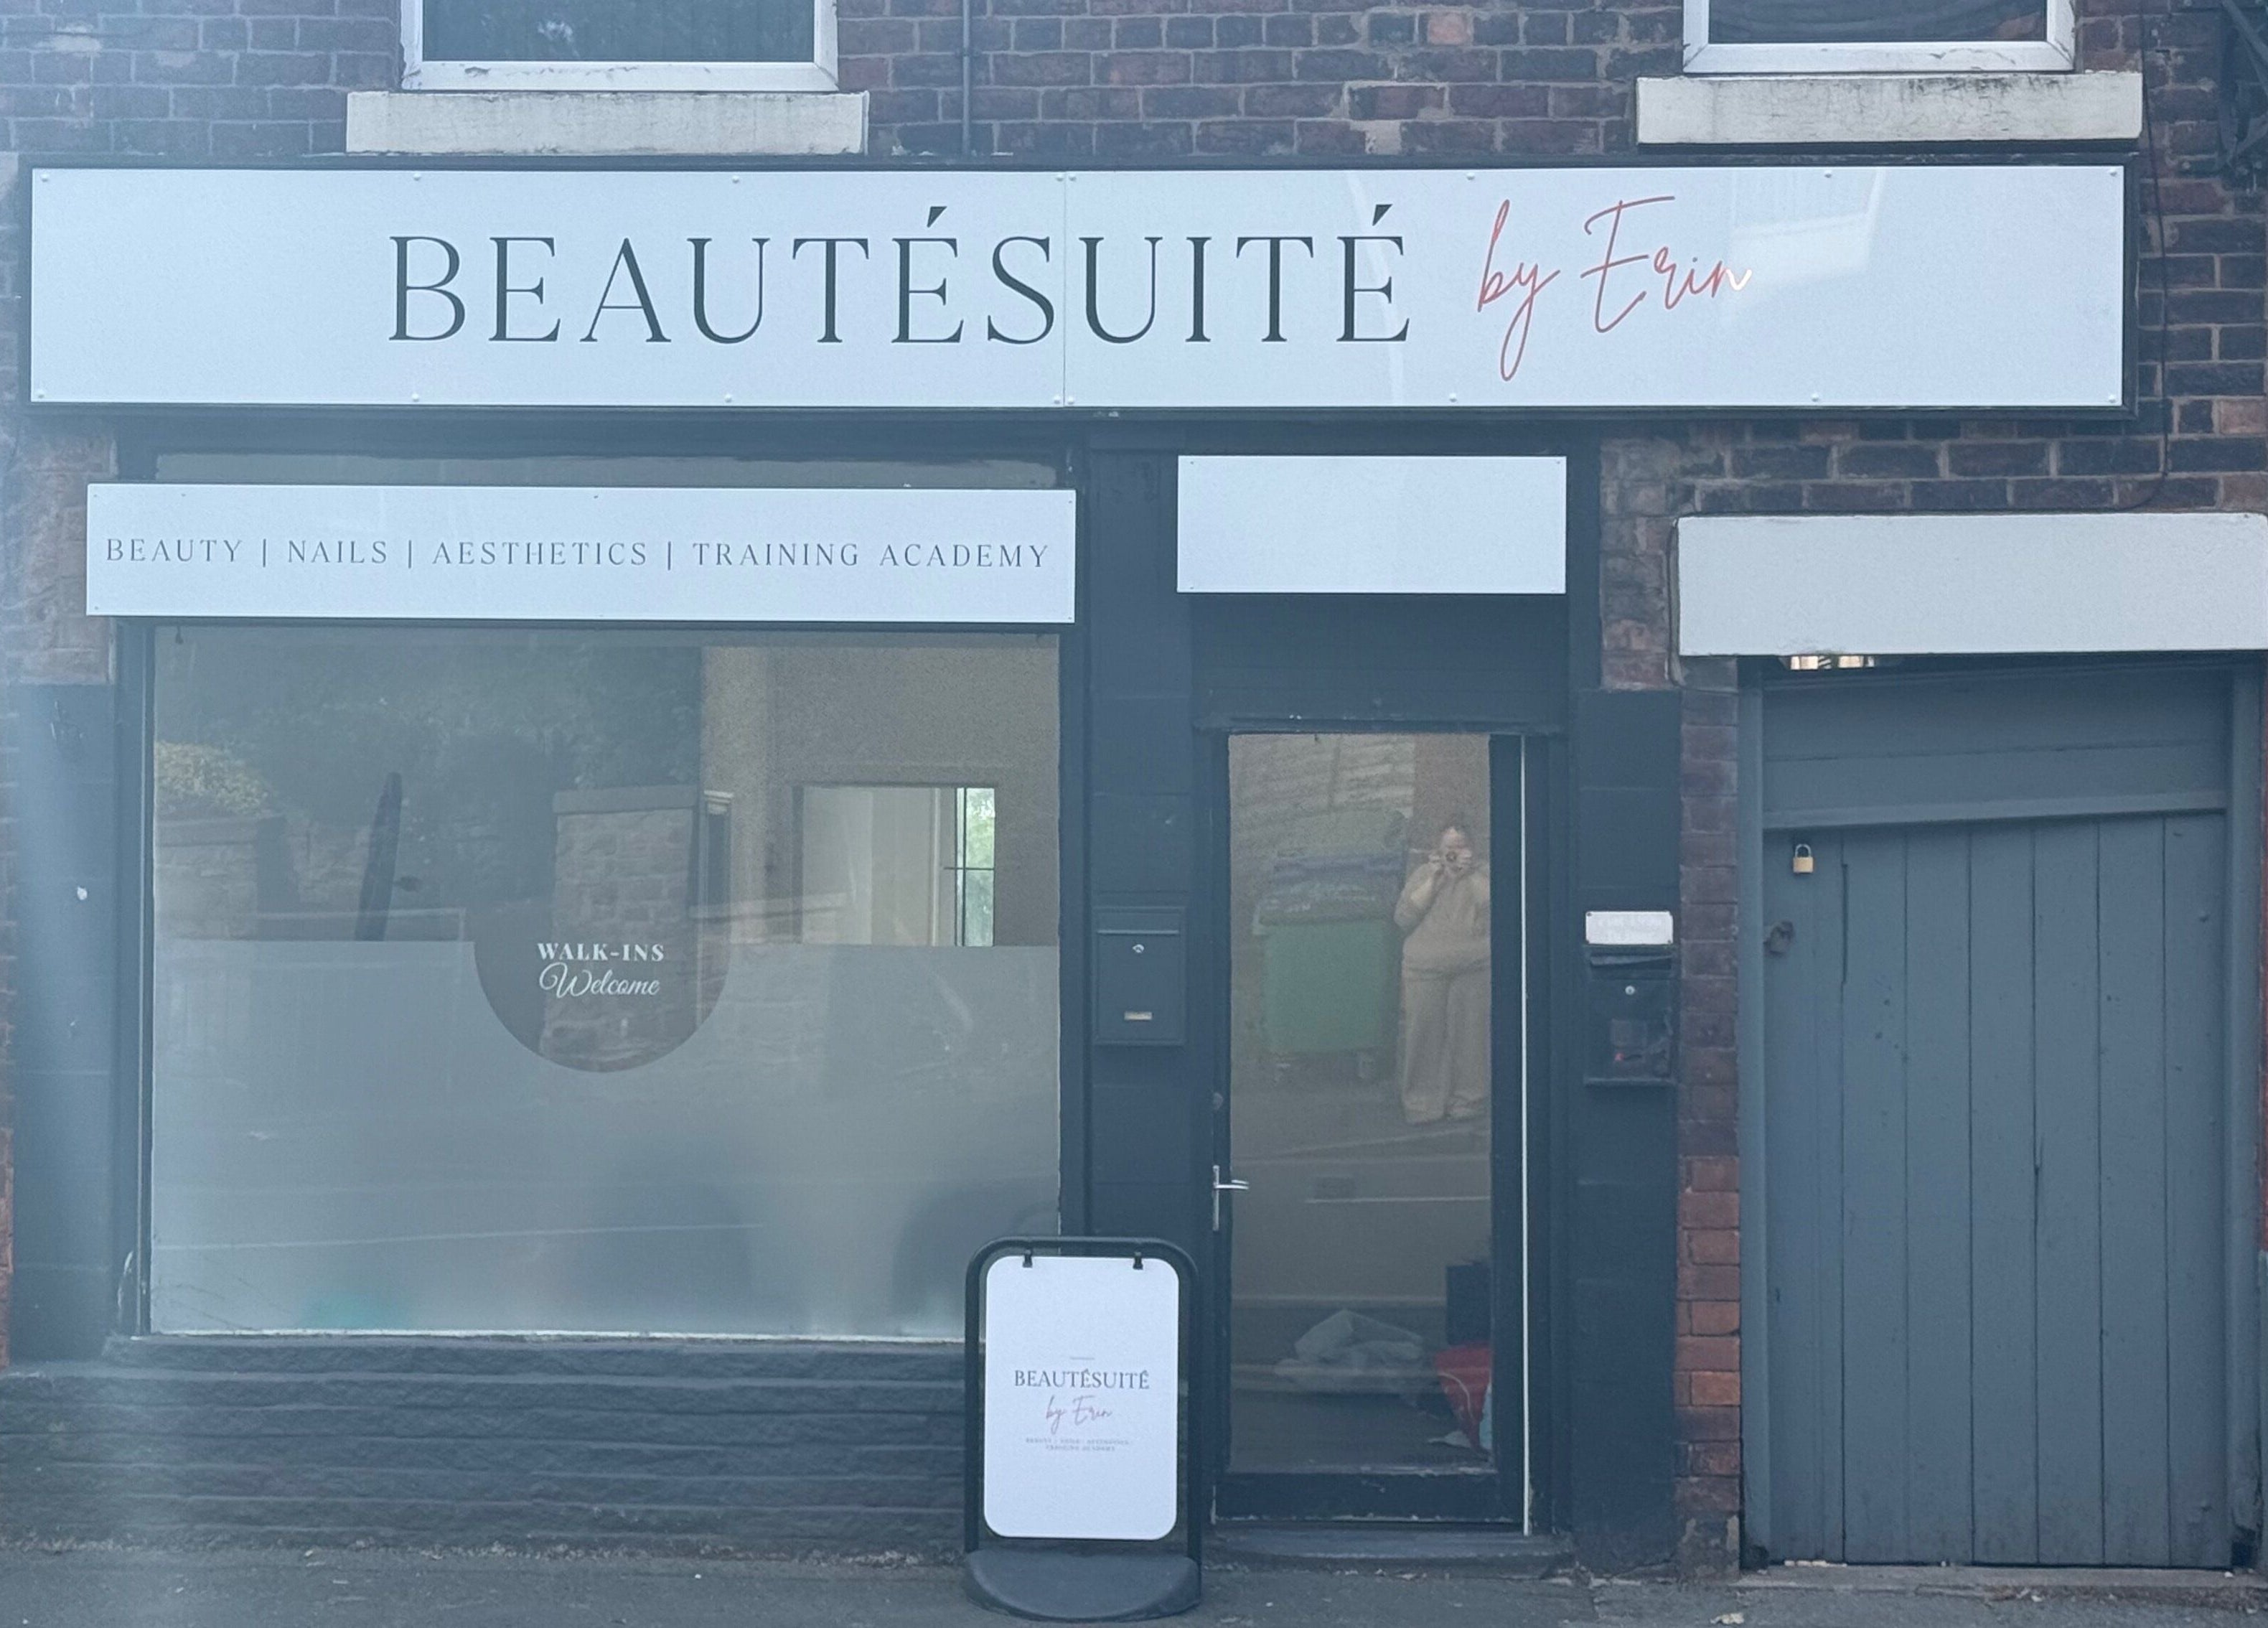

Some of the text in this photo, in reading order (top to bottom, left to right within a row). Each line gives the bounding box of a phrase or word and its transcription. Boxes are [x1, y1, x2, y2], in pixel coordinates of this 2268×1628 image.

[388, 195, 1753, 382] BEAUTÉSUITÉ by Erin
[106, 538, 243, 563] BEAUTY
[288, 540, 387, 564] NAILS
[431, 541, 646, 566] AESTHETICS
[692, 543, 858, 566] TRAINING
[879, 543, 1048, 568] ACADEMY
[537, 942, 665, 962] WALK-INS
[538, 962, 660, 999] Welcome
[1045, 1395, 1113, 1436] by Erin
